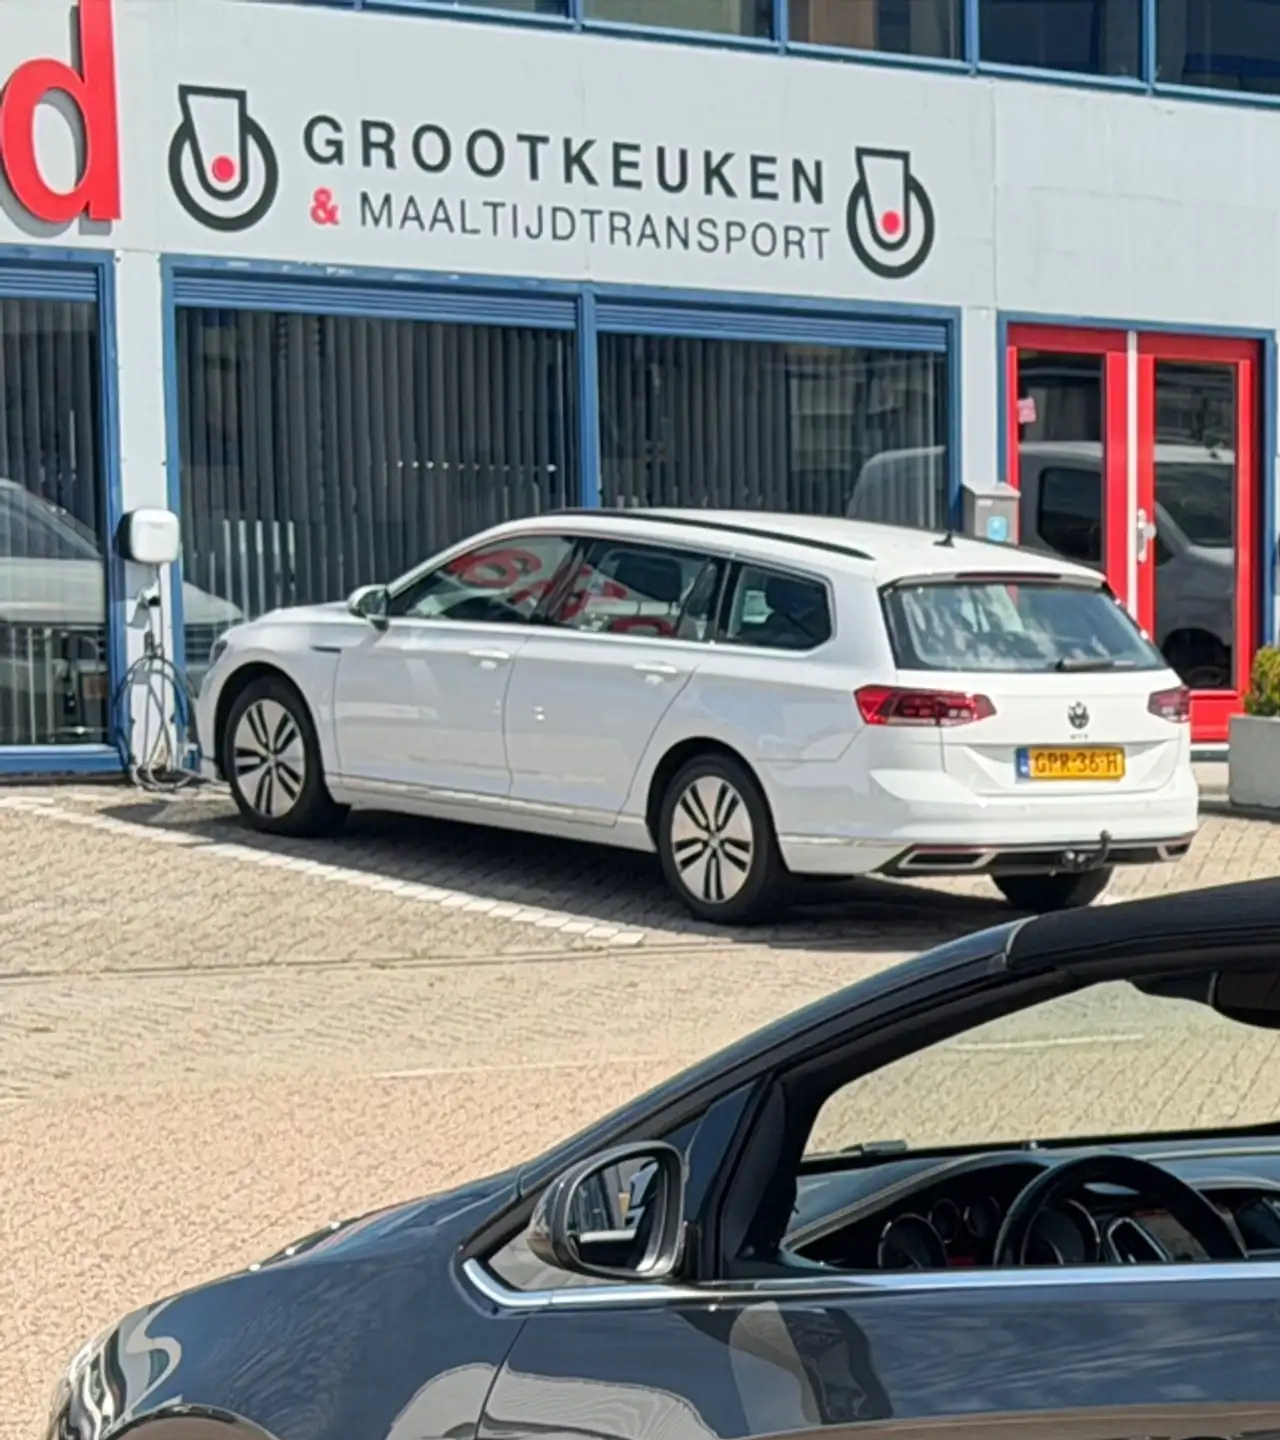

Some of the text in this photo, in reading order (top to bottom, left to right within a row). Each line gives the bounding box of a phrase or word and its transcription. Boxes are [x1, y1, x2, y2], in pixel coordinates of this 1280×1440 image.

[303, 114, 825, 205] GROOTKEUKEN
[310, 187, 831, 261] & MAALTIJDTRANSPORT
